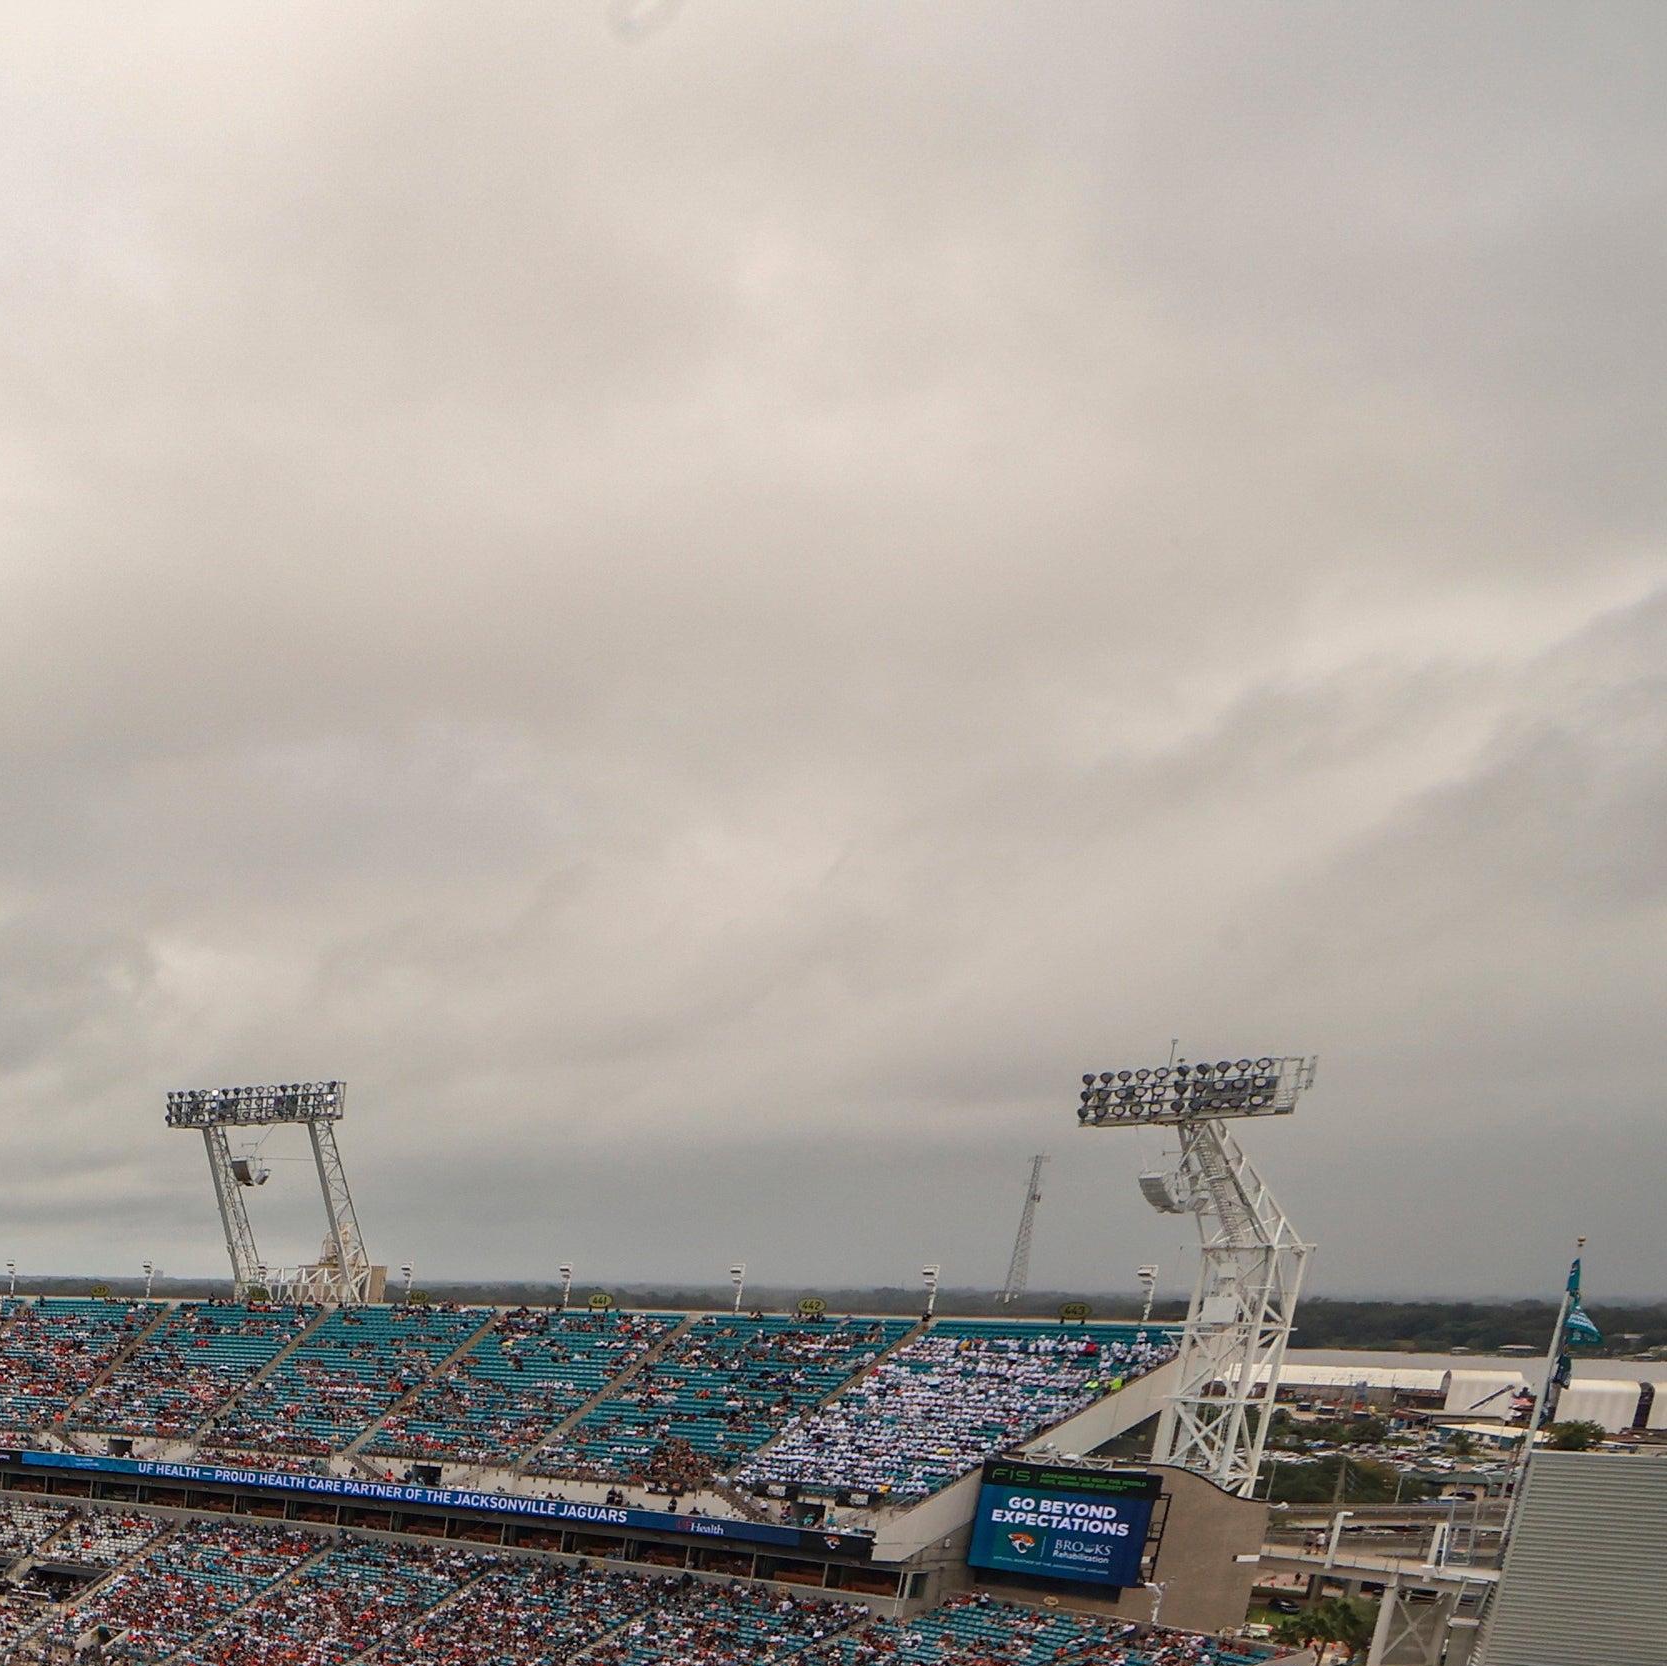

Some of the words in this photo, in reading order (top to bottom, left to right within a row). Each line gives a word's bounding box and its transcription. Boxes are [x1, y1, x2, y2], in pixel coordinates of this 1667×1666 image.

[138, 1463, 153, 1473] UF
[156, 1465, 199, 1477] HEALTH
[215, 1470, 256, 1483] PROUD
[259, 1475, 305, 1488] HEALTH
[308, 1479, 340, 1492] CARE
[344, 1482, 402, 1498] PARTNER
[405, 1488, 422, 1500] OF
[426, 1490, 450, 1503] THE
[454, 1493, 556, 1515] JACKSONVILLE
[559, 1503, 627, 1523] JAGUARS
[1008, 1497, 1035, 1511] GO
[1039, 1500, 1117, 1520] BEYOND
[691, 1521, 724, 1535] Health
[991, 1509, 1129, 1537] EXPECTATIONS
[1053, 1550, 1109, 1564] Rehabilitation
